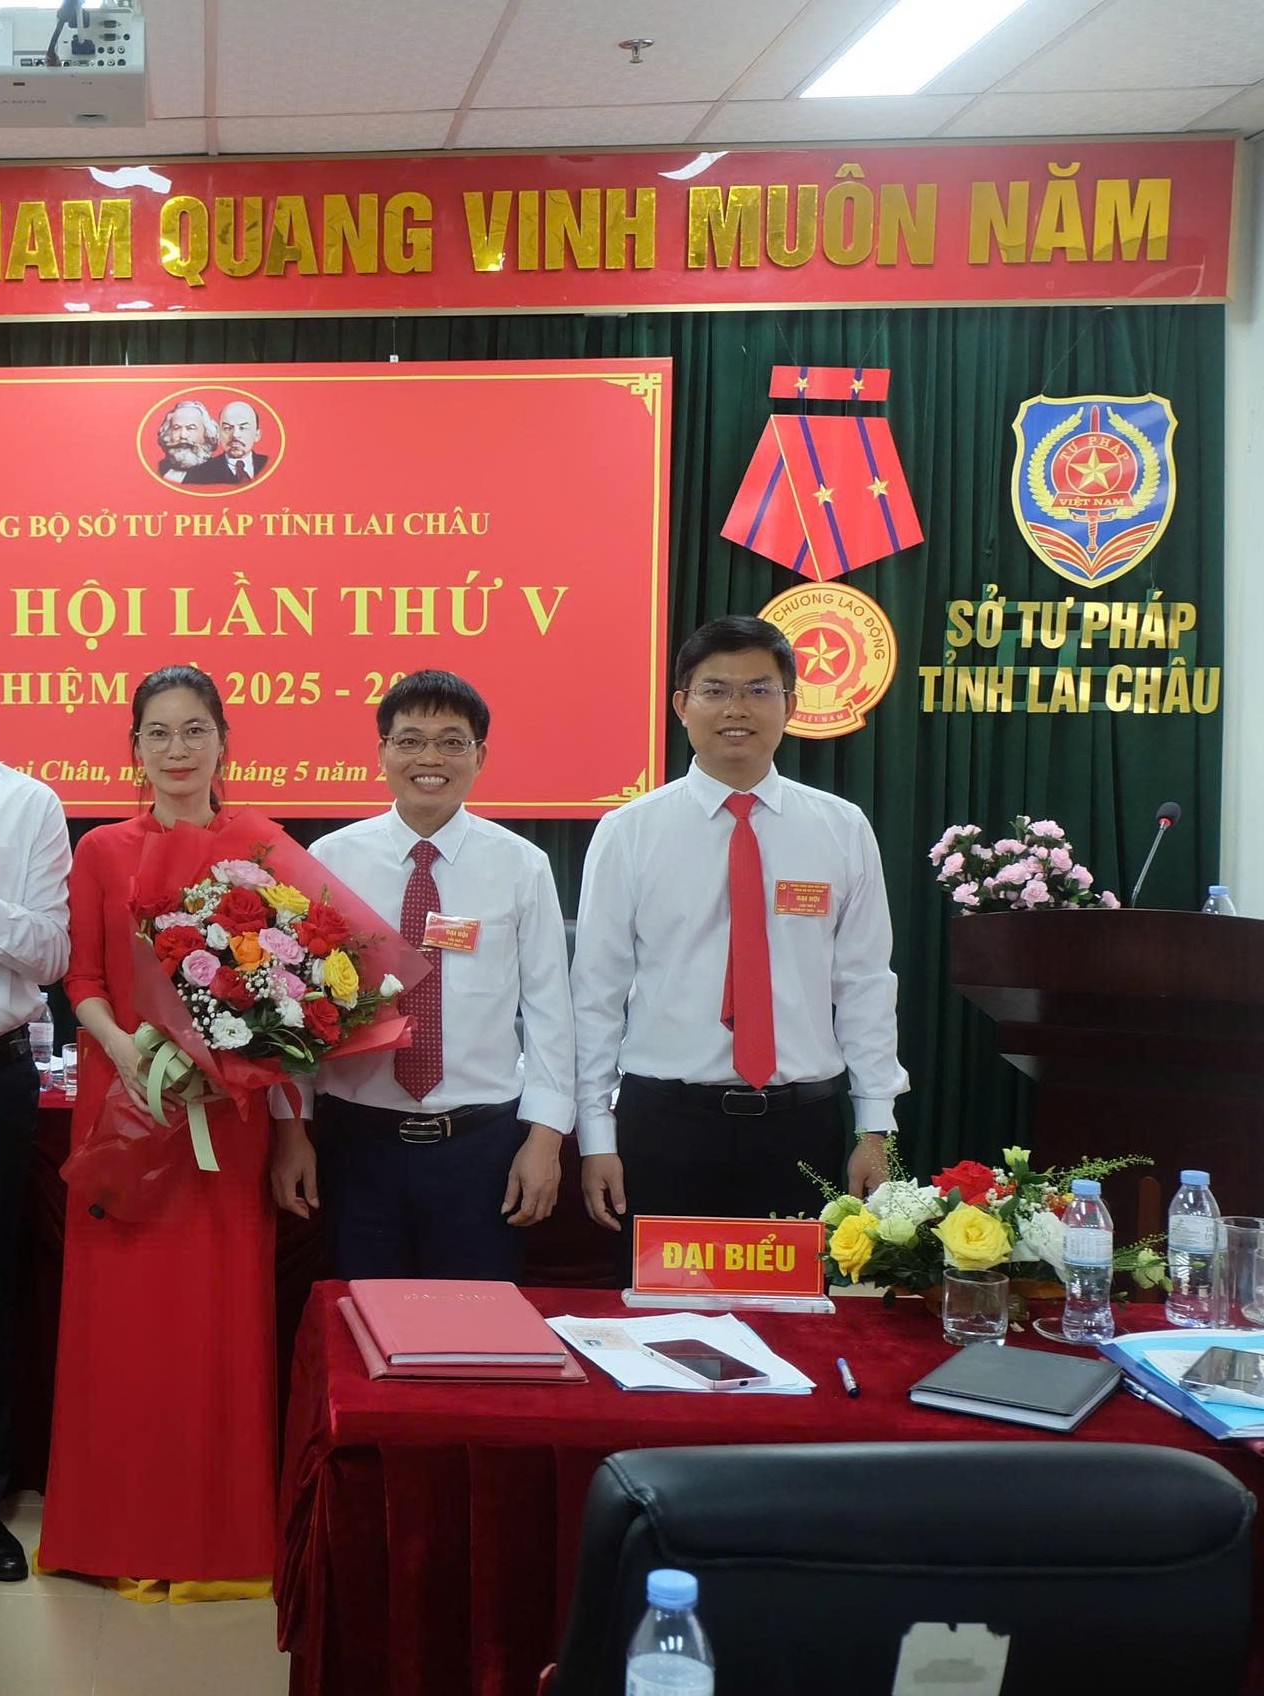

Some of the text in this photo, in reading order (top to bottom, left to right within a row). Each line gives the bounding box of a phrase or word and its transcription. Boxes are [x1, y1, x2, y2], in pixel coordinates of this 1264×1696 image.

[159, 190, 434, 287] QUANG
[462, 186, 656, 272] VINH
[687, 162, 938, 269] MUÔN
[969, 161, 1171, 265] NĂM
[1093, 498, 1125, 506] NAM
[29, 511, 70, 543] BỘ
[77, 508, 118, 538] SỞ
[123, 510, 168, 537] TƯ
[174, 507, 254, 537] PHÁP
[261, 507, 336, 536] TỈNH
[343, 513, 395, 536] LAI
[402, 506, 491, 536] CHÂU
[10, 578, 148, 651] HỘI
[169, 571, 318, 637] LẦN
[340, 570, 505, 637] THỨ
[520, 586, 570, 637] V
[838, 596, 865, 617] LAO
[946, 584, 1197, 649] SỞ TƯ PHÁP
[225, 671, 322, 705] 2025
[918, 650, 1221, 714] TỈNH LAI CHÂU
[40, 760, 111, 785] Châu,
[221, 760, 289, 787] tháng
[293, 760, 310, 782] 5
[315, 760, 368, 782] năm
[662, 1233, 796, 1275] ĐẠI BIỂU
